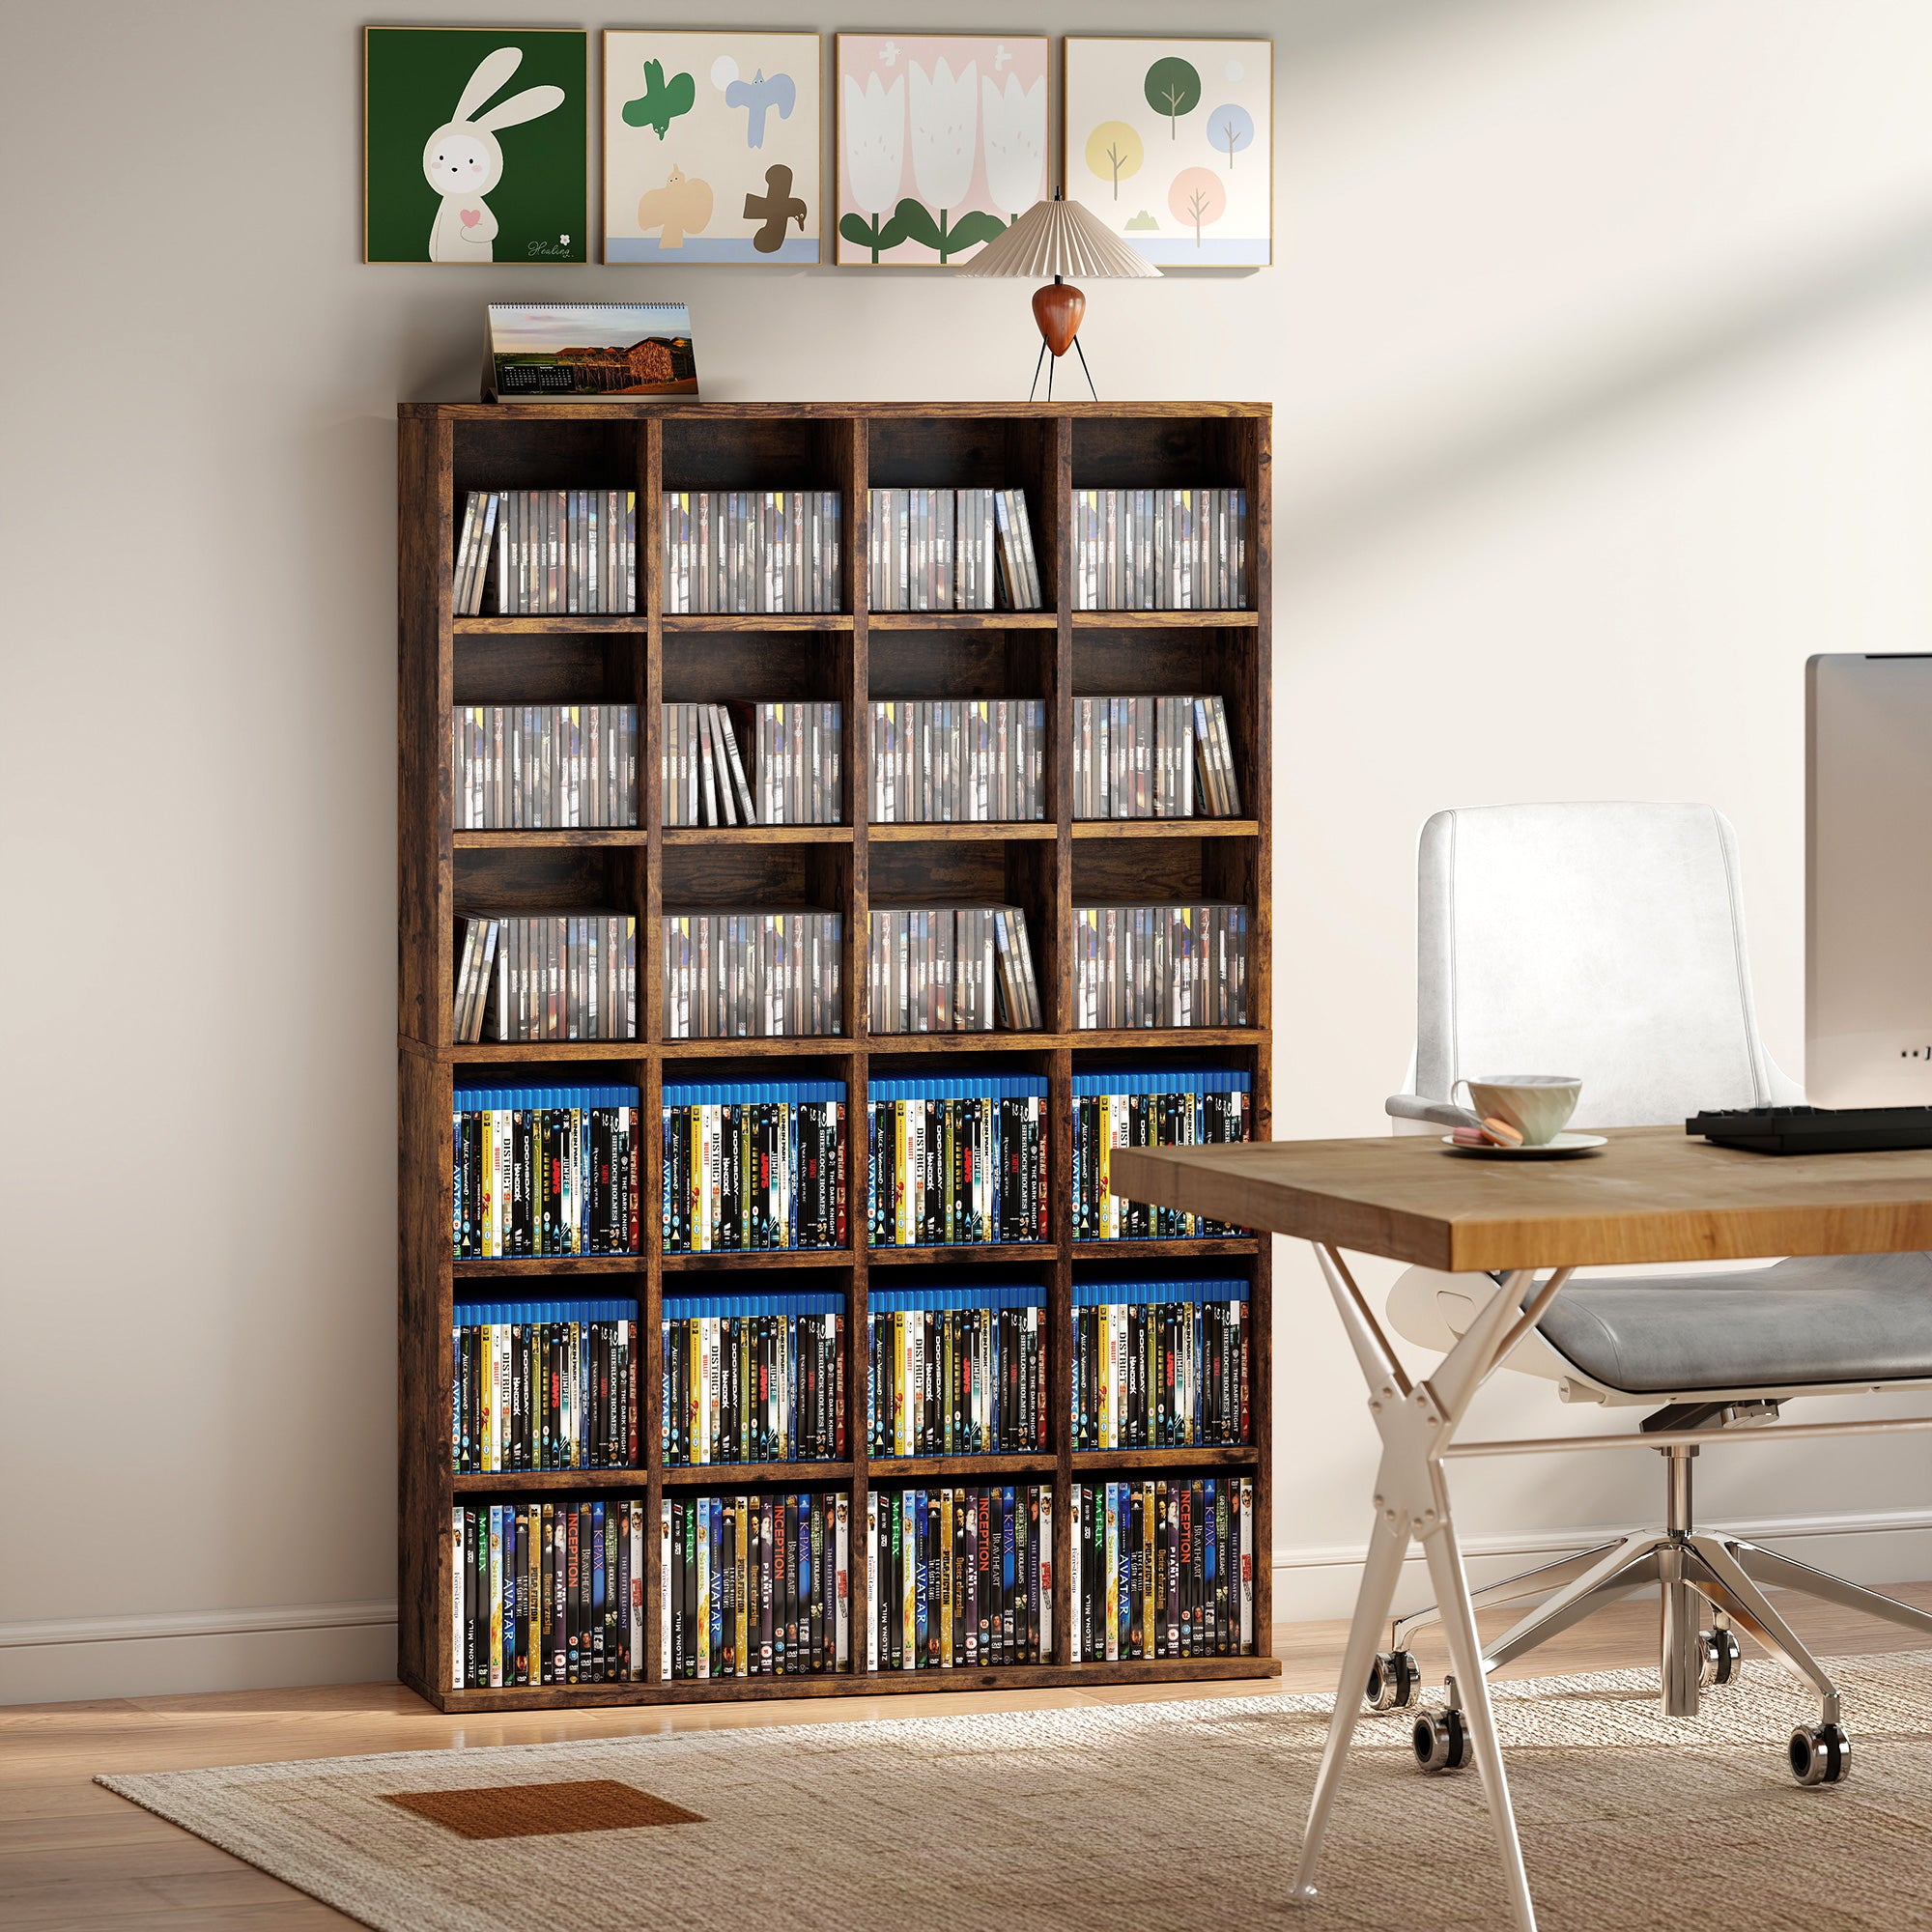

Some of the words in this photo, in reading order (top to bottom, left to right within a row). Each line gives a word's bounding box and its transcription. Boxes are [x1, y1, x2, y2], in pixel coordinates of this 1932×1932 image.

[568, 1513, 578, 1587] INCEPTION
[593, 1530, 603, 1570] K-PAX
[775, 1505, 784, 1578] INCEPTION
[800, 1521, 810, 1562] K-PAX
[980, 1497, 988, 1571] INCEPTION
[1004, 1514, 1013, 1553] K-PAX
[1180, 1490, 1190, 1563] INCEPTION
[1194, 1525, 1203, 1578] BRAVEHEART
[1206, 1506, 1214, 1546] K-PAX
[582, 1548, 591, 1604] BRAVEHEART
[787, 1541, 797, 1595] BRAVEHEART
[992, 1533, 1001, 1587] BRAVEHEART
[1119, 1554, 1129, 1616] AVATAR
[503, 1578, 514, 1642] AVATAR
[710, 1570, 721, 1634] AVATAR
[916, 1562, 926, 1625] AVATAR
